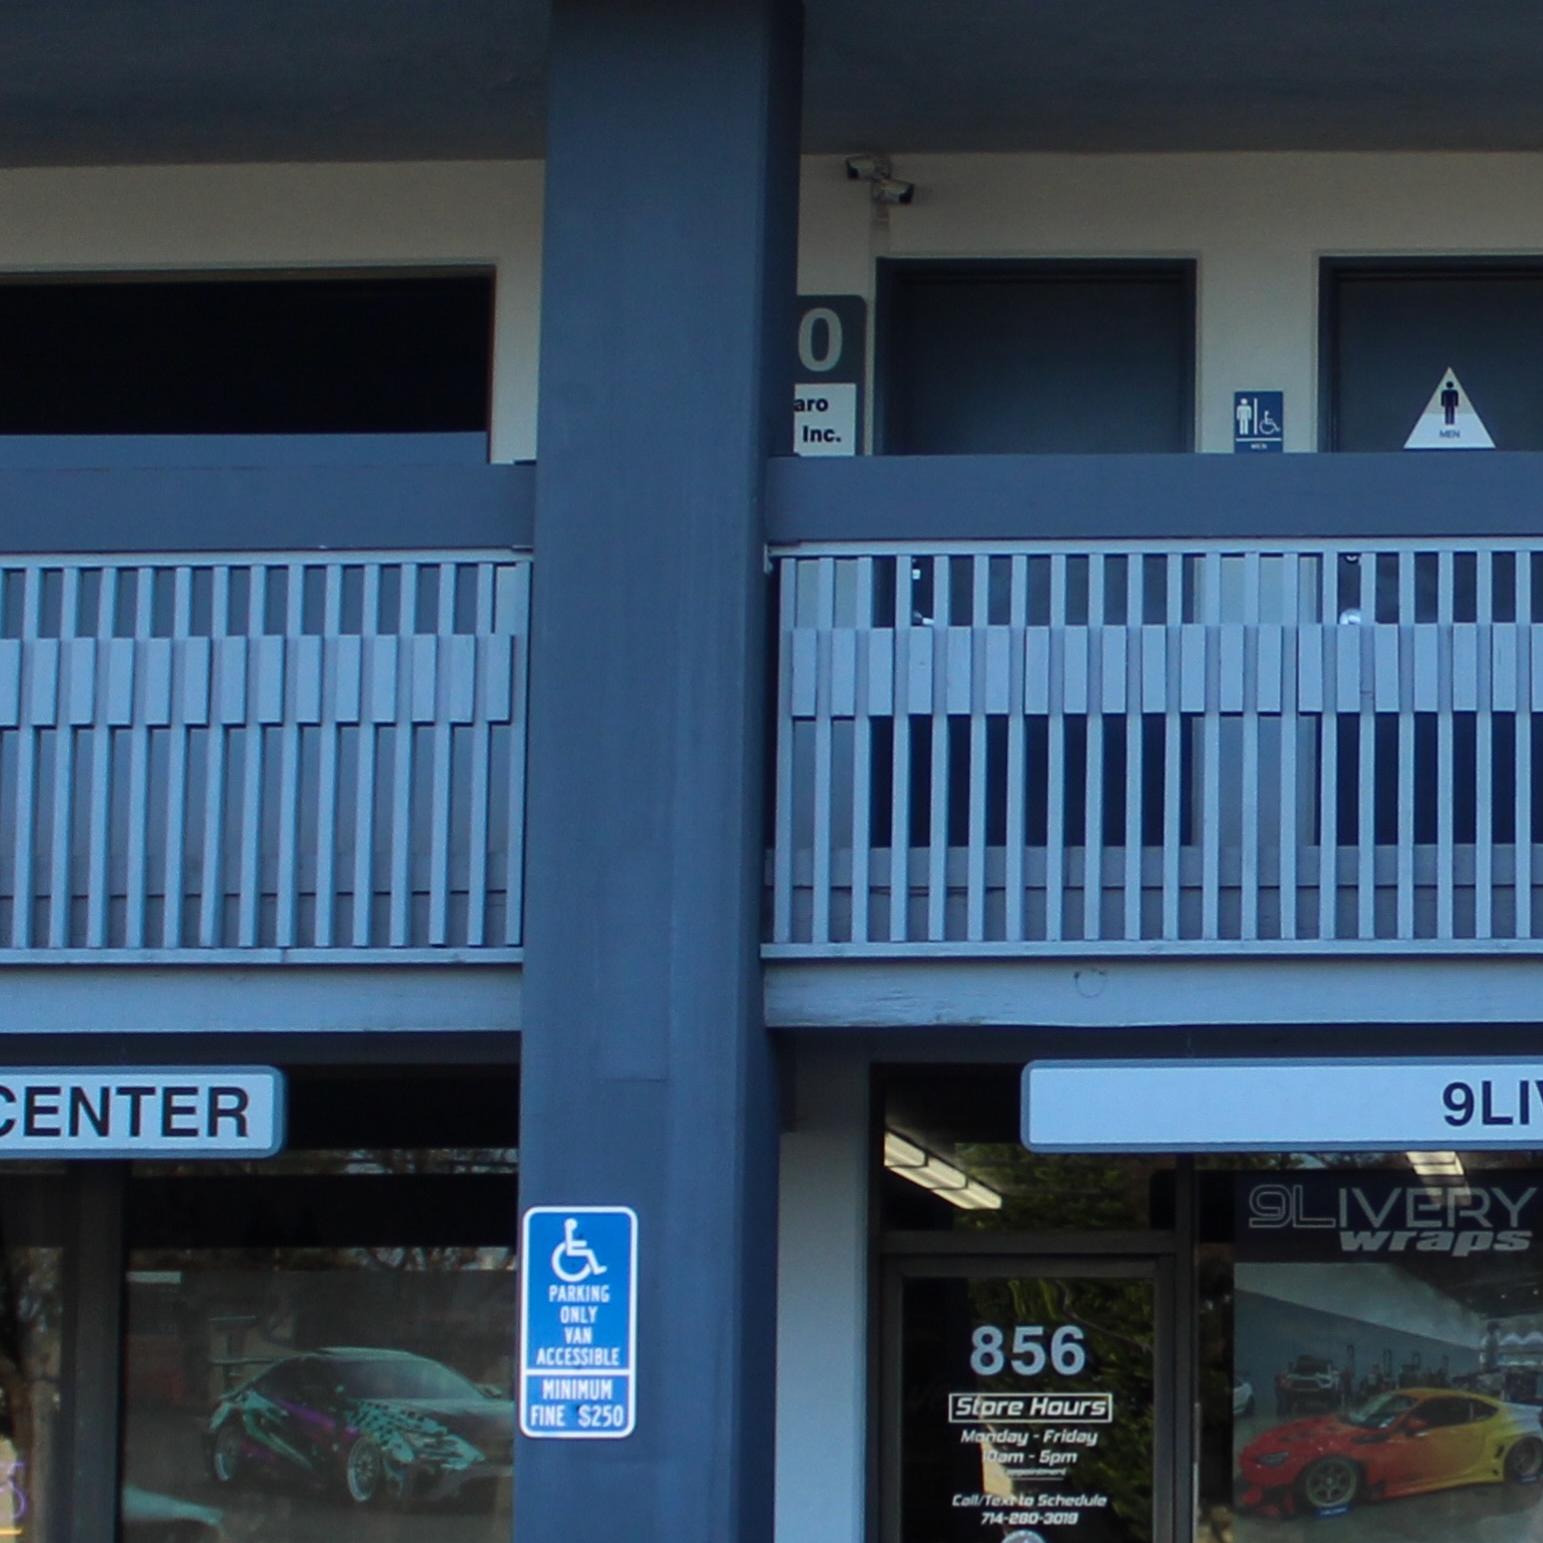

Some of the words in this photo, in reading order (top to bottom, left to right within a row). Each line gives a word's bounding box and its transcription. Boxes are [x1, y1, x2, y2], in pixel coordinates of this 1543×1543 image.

[802, 425, 841, 442] Inc.
[1439, 430, 1460, 439] MEN
[1248, 1184, 1538, 1228] 9LIVERY
[1339, 1230, 1533, 1258] wraps
[548, 1285, 610, 1303] PARKING
[560, 1306, 598, 1324] ONLY
[564, 1327, 592, 1344] VAN
[536, 1348, 620, 1366] ACCESSIBLE
[969, 1324, 1086, 1377] 856
[542, 1379, 613, 1401] MINIMUM
[531, 1405, 565, 1427] FINE
[577, 1404, 624, 1427] $250
[955, 1396, 1025, 1417] Store
[1029, 1396, 1107, 1417] Hours
[960, 1428, 1029, 1447] Monday
[1043, 1428, 1098, 1447] Friday
[983, 1449, 1024, 1464] 0am
[1039, 1449, 1078, 1467] 5pm
[1037, 1493, 1108, 1508] Schedule
